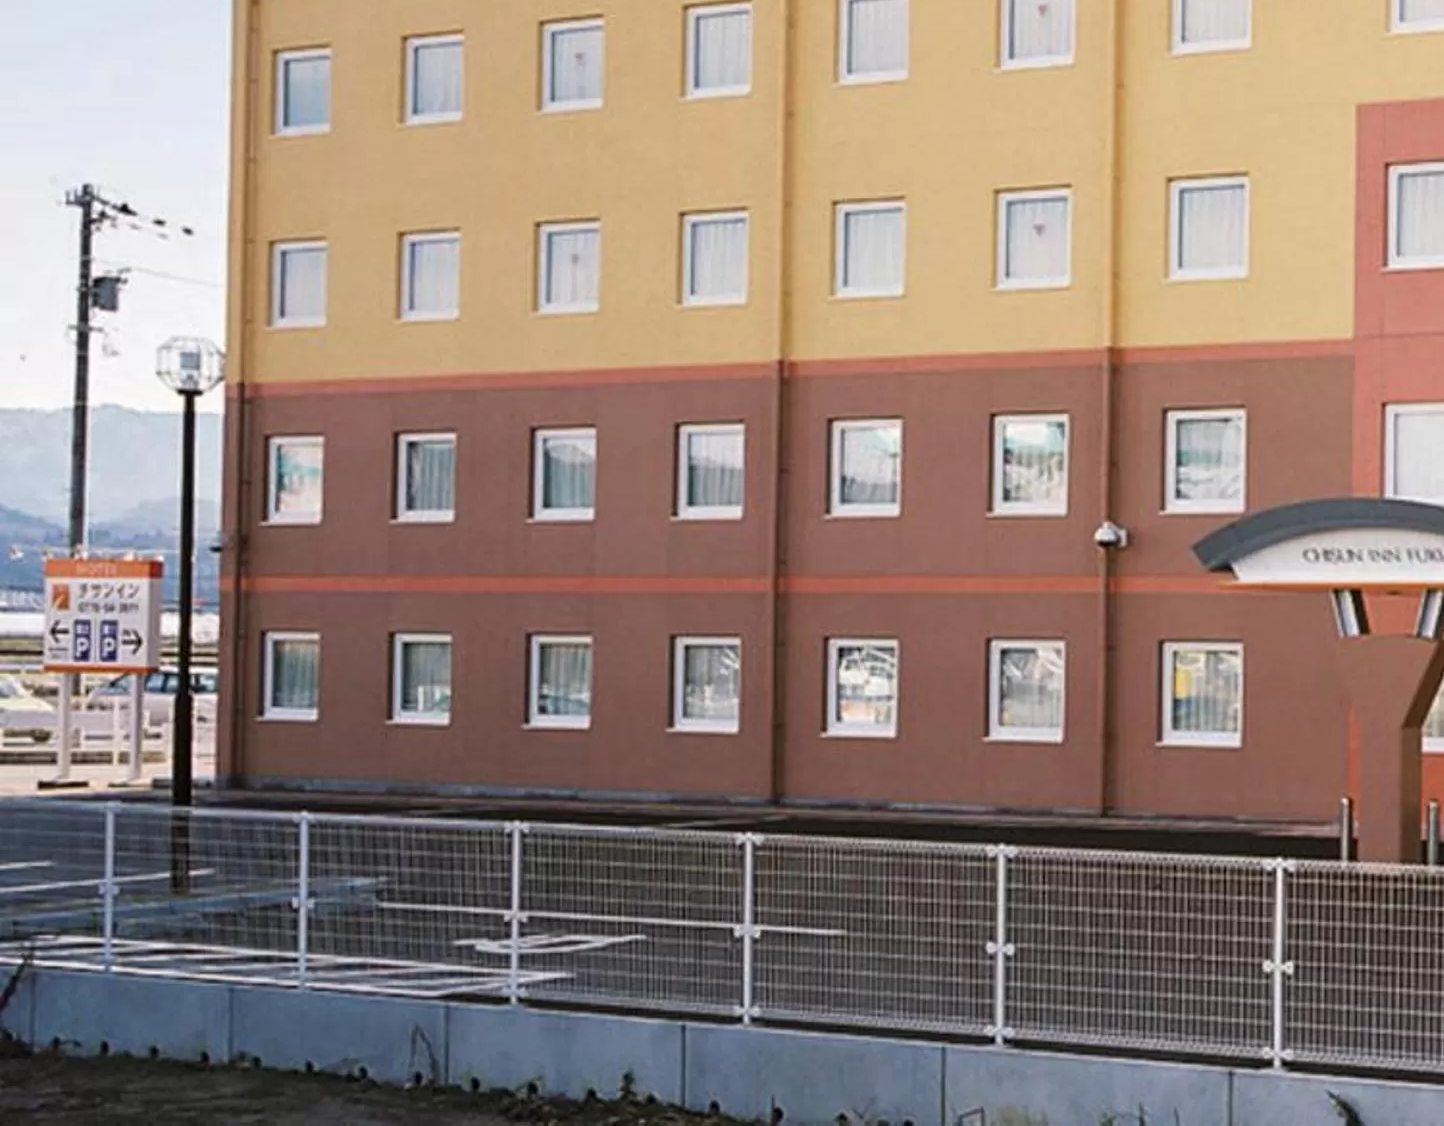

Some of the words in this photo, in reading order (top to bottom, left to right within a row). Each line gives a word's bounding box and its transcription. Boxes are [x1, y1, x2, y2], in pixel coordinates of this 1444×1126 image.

[1367, 547, 1402, 564] INN
[76, 637, 89, 658] P
[102, 637, 116, 658] P
